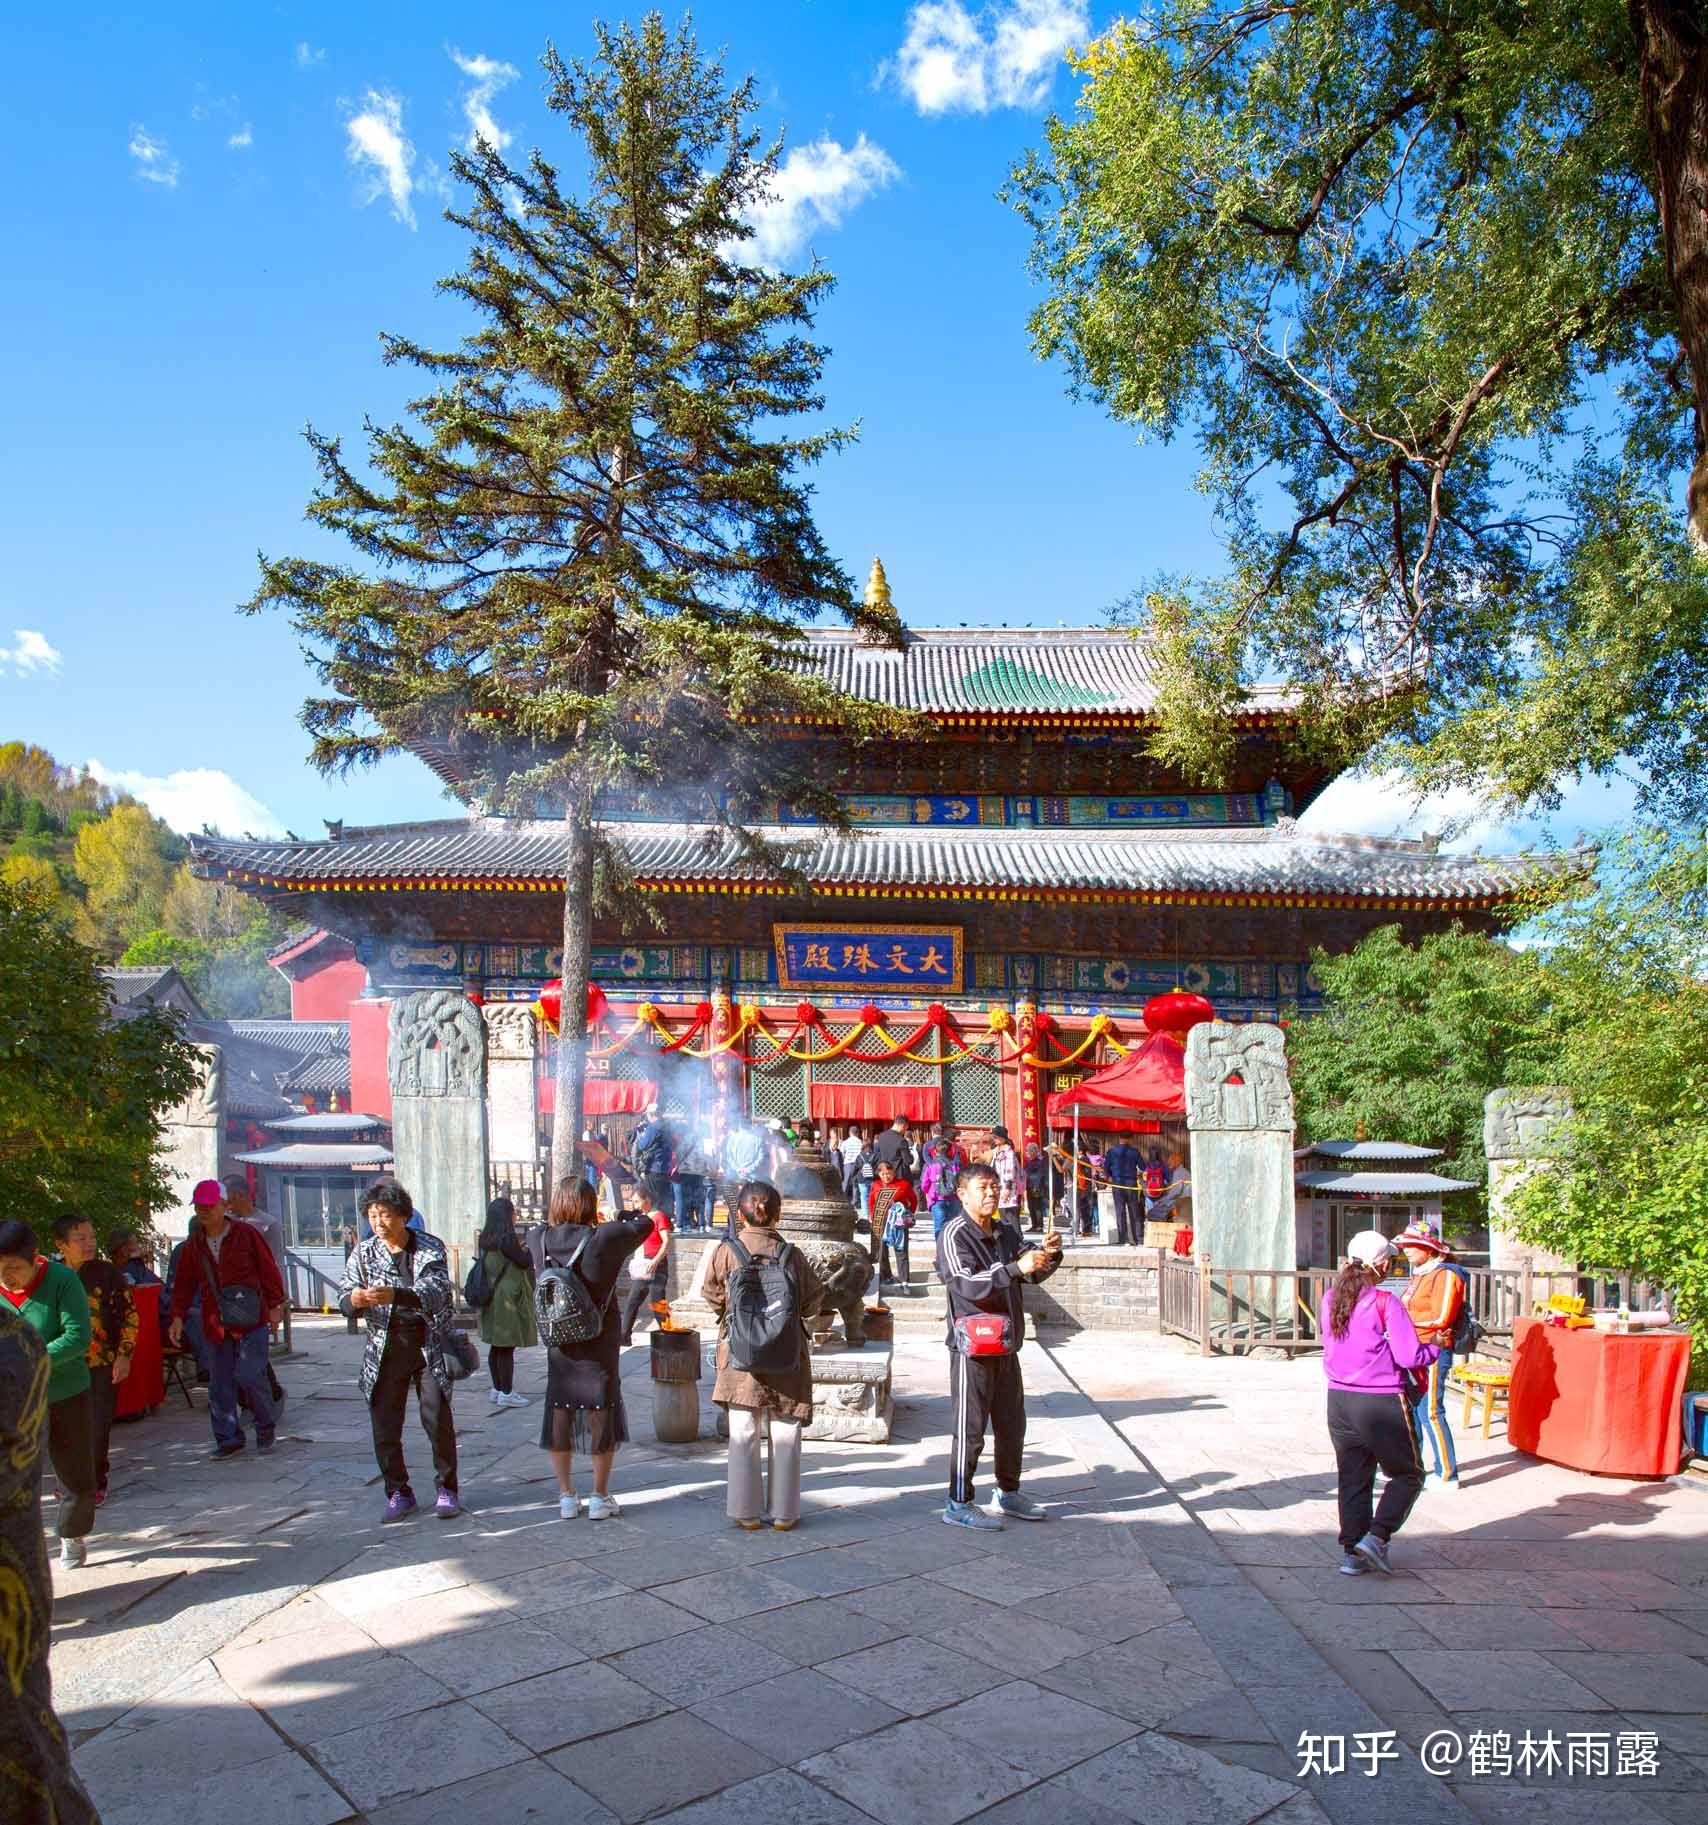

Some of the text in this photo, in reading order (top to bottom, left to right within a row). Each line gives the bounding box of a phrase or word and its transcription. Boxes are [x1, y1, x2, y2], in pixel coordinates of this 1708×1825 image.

[802, 943, 948, 974] 大文殊殿
[585, 1058, 609, 1070] 入口
